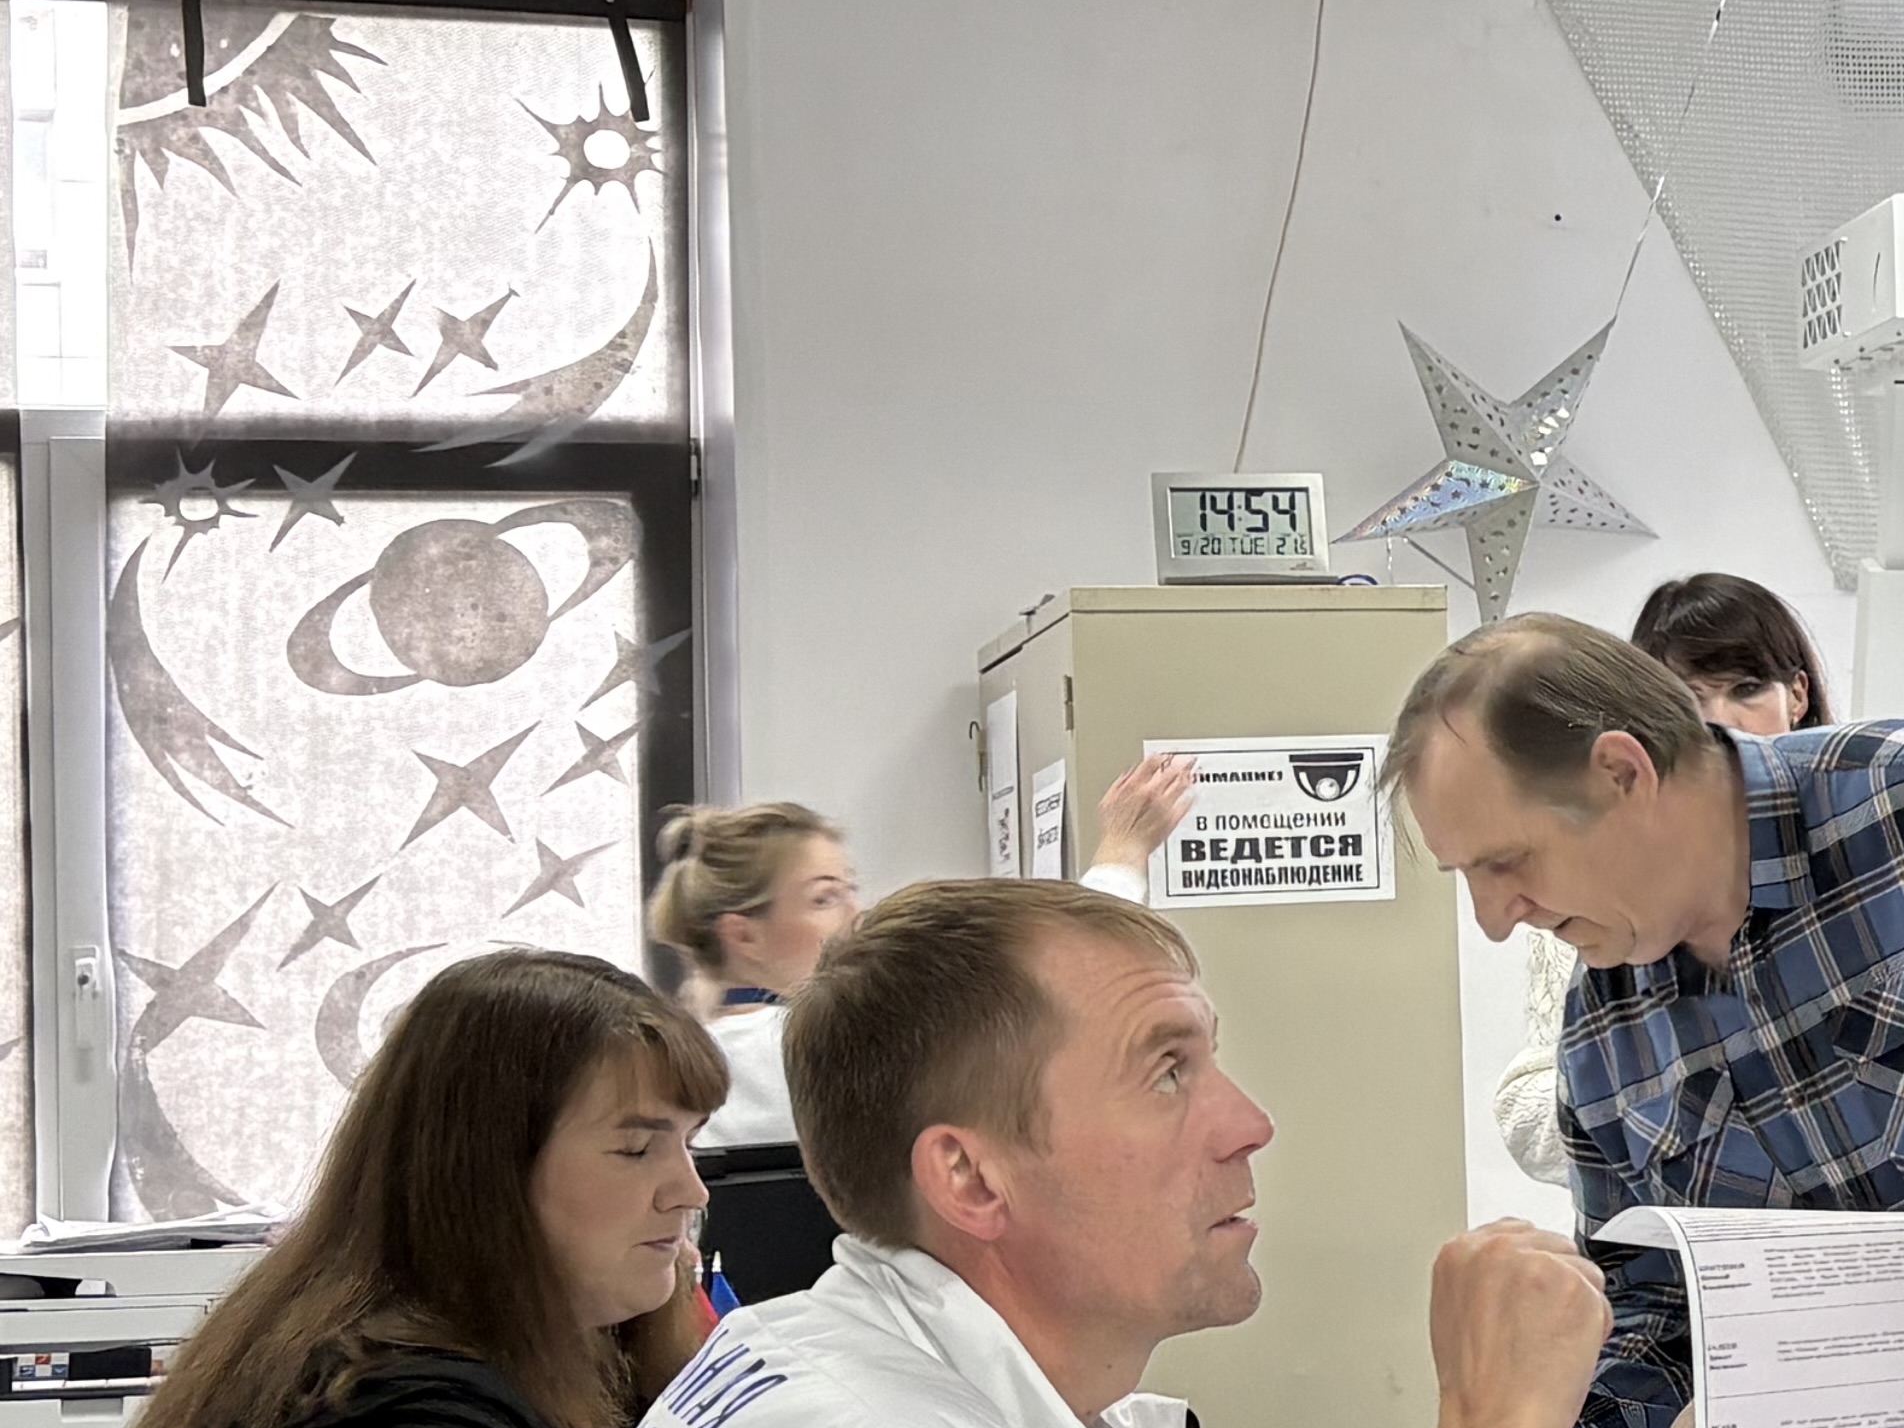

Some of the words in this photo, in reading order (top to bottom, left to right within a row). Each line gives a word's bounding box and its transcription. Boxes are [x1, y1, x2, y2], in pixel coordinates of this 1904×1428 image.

[1200, 491, 1297, 532] 14:54
[1228, 537, 1265, 556] TUE
[1181, 834, 1363, 863] ВЕДЕТСЯ
[1182, 863, 1364, 890] ВИДЕОНАБЛЮДЕНИЕ
